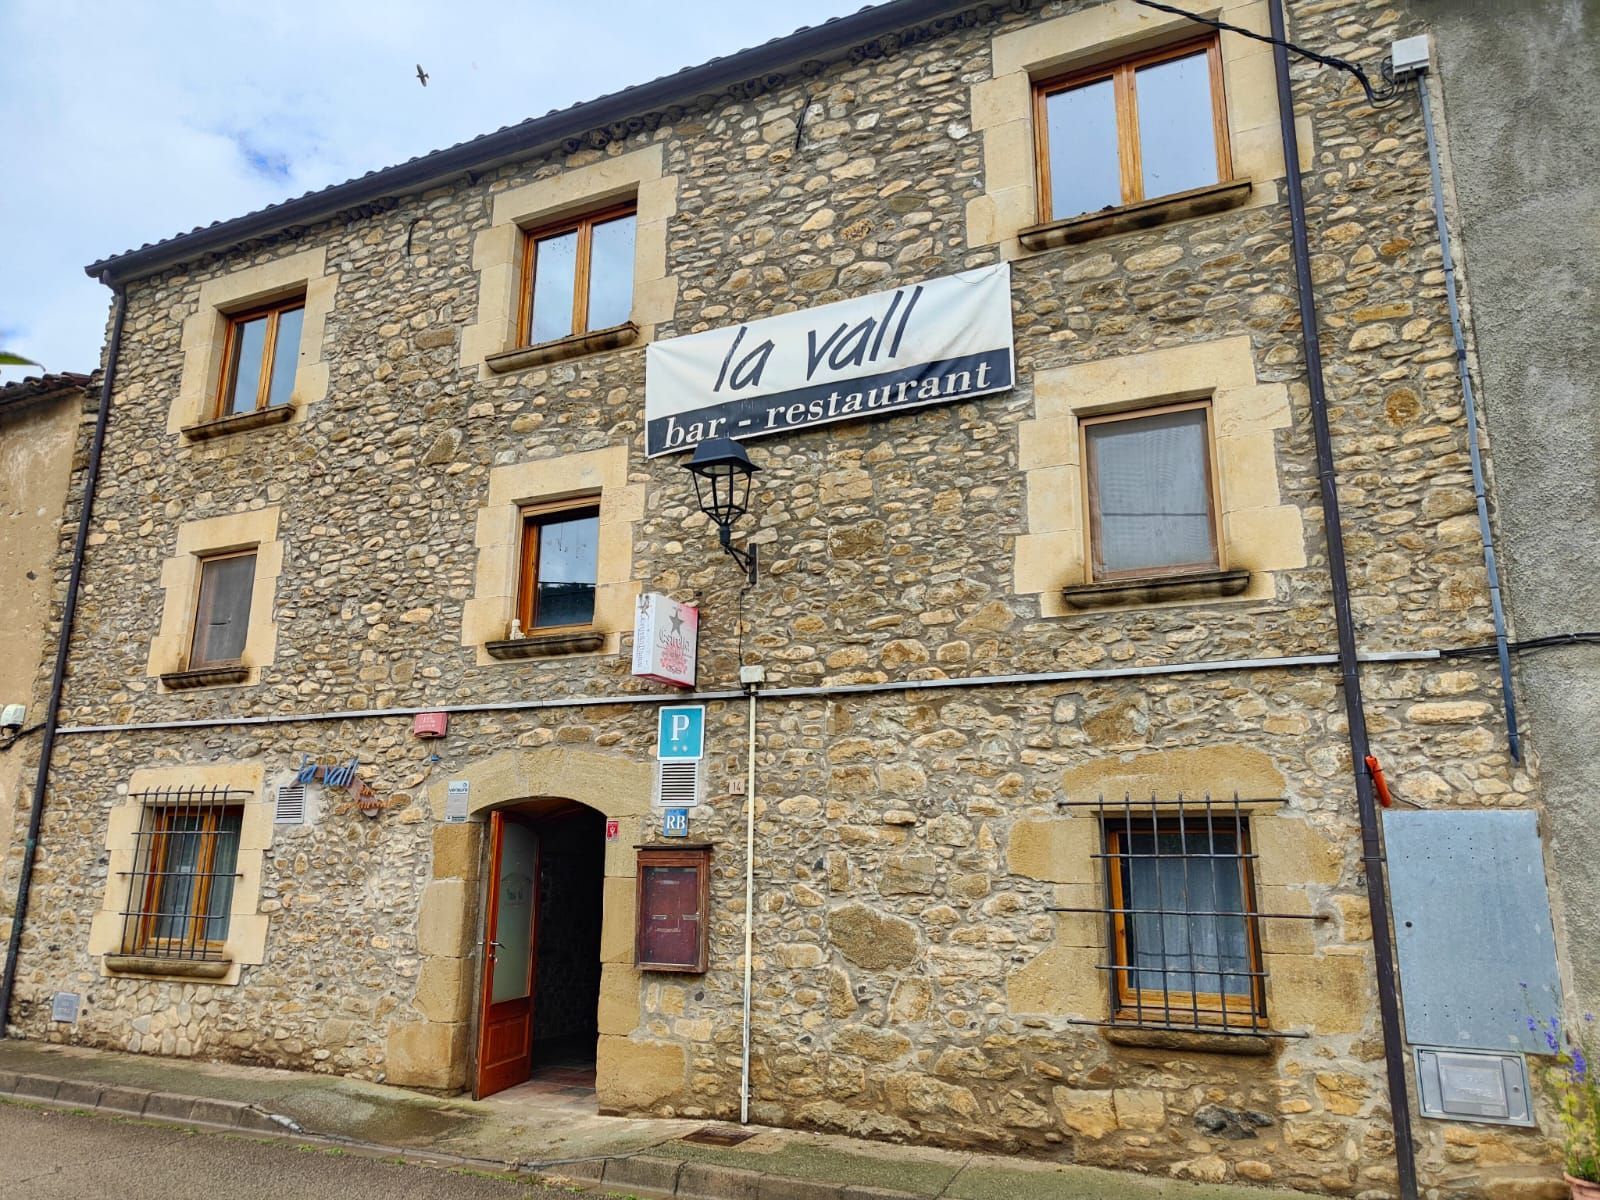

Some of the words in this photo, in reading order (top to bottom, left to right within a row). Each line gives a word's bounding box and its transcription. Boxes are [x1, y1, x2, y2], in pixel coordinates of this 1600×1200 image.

[713, 326, 775, 393] la
[807, 285, 923, 382] vall
[664, 417, 727, 448] bar
[738, 419, 752, 428] -
[764, 361, 992, 429] restaurant
[671, 714, 690, 741] P
[298, 753, 319, 784] la
[322, 754, 359, 787] vall
[732, 781, 741, 792] 14
[667, 815, 686, 830] RB
